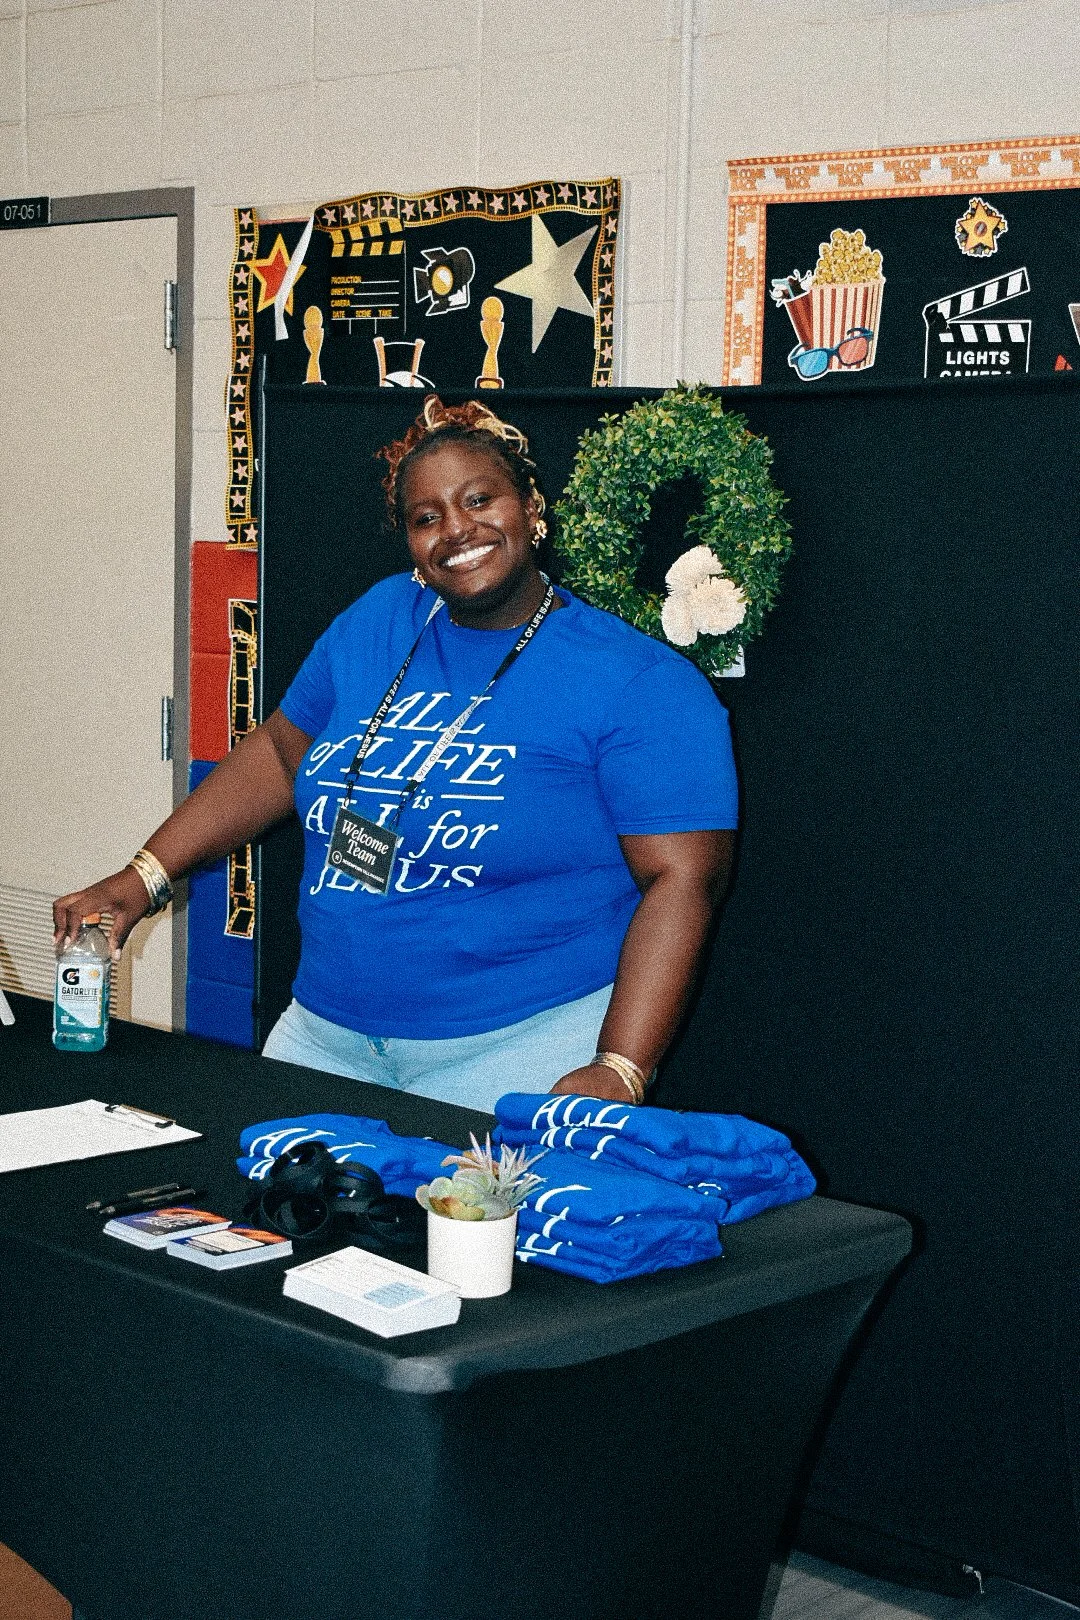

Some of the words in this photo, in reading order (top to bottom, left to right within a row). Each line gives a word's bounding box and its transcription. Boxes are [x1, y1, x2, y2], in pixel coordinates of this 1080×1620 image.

[4, 204, 41, 220] 07-051
[332, 310, 346, 319] DATE
[945, 350, 1010, 366] LIGHTS
[515, 639, 529, 652] ALL
[524, 626, 535, 638] OF
[530, 612, 544, 629] LIFE
[540, 605, 548, 615] IS
[388, 678, 401, 697] LIFE
[384, 694, 393, 705] IS
[358, 690, 493, 735] ALL
[375, 702, 389, 718] ALL
[367, 717, 382, 734] FOR
[356, 734, 373, 760] JESUS
[305, 734, 362, 777] of
[339, 736, 517, 786] LIFE
[411, 788, 434, 810] is
[341, 819, 390, 855] Welcome
[408, 810, 499, 859] for
[346, 838, 377, 866] Team
[62, 967, 80, 986] G
[61, 986, 98, 996] GATORLYTE
